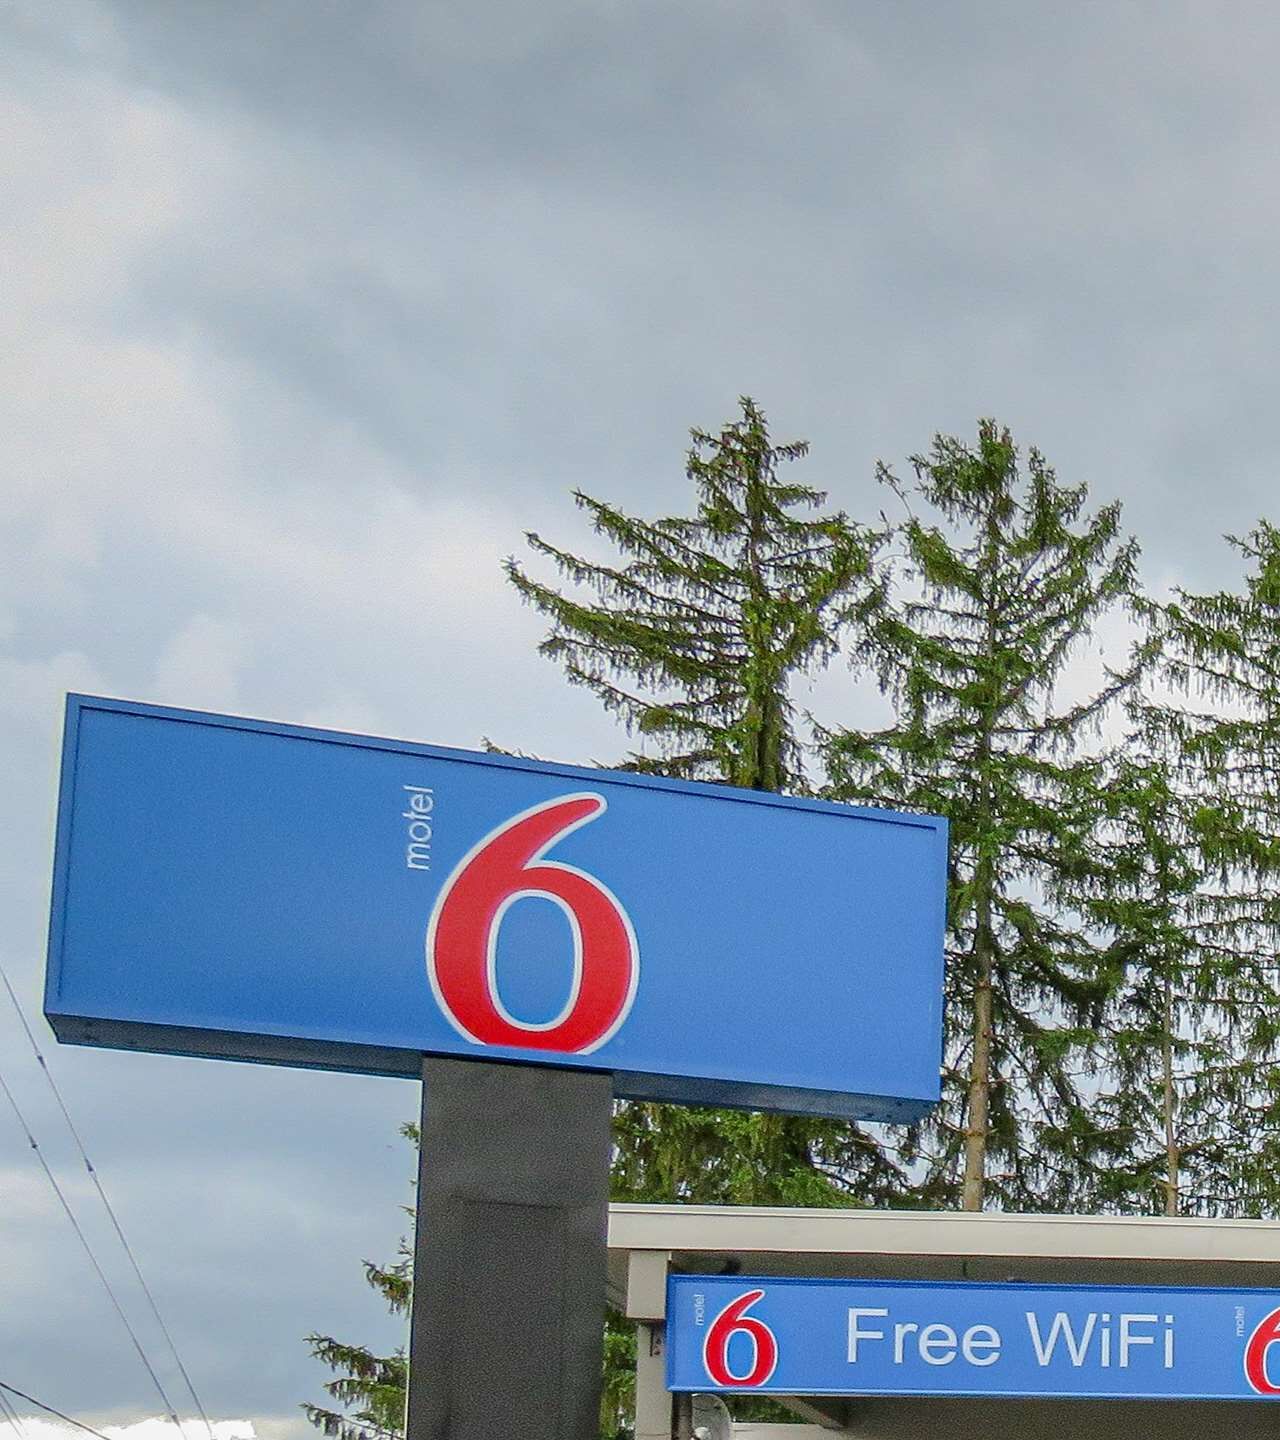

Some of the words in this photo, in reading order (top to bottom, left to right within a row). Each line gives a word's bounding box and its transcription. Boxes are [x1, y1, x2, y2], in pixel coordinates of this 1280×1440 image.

[403, 785, 434, 871] motel
[425, 791, 641, 1056] 6
[693, 1293, 706, 1327] motel
[703, 1288, 778, 1388] 6
[846, 1307, 1002, 1367] Free
[1024, 1311, 1176, 1370] WiFi
[1234, 1305, 1248, 1338] motel
